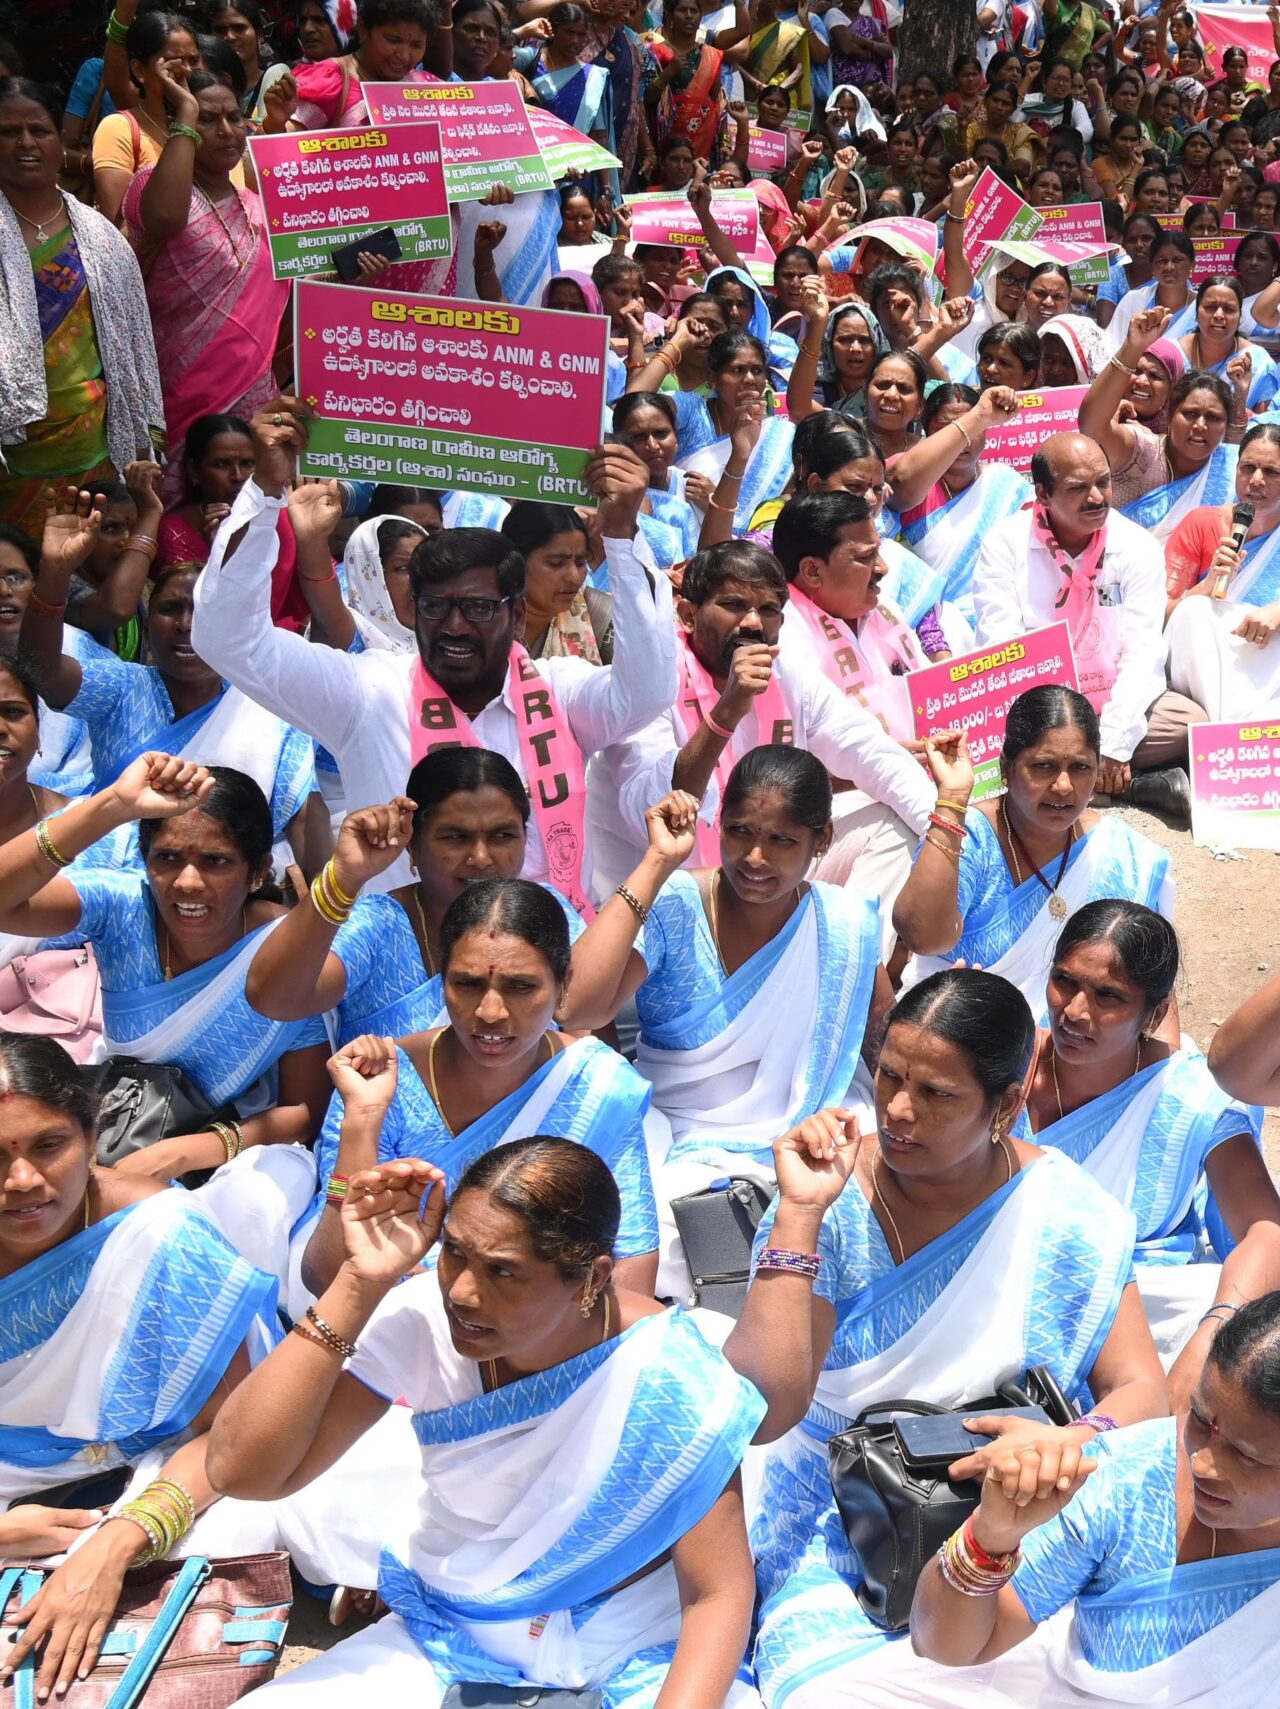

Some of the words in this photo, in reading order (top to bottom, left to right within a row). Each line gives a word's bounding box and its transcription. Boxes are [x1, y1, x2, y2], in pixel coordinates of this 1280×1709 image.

[402, 86, 474, 100] ఆశాలకు
[488, 104, 514, 116] ఇవ్వాలి.
[502, 122, 527, 135] ఇవ్వాలి.
[298, 131, 388, 154] ఆశాలకు
[273, 163, 298, 182] అర్హత
[302, 159, 331, 174] కలిగిన
[334, 155, 372, 172] ఆశాలకు
[375, 154, 398, 168] ANM
[402, 153, 410, 164] &
[414, 150, 439, 164] GNM
[277, 181, 333, 200] ఉద్యోగాలలో
[336, 176, 378, 192] అవకాశం
[382, 171, 429, 190] కల్పించాలి.
[516, 172, 548, 188] (BRTU)
[283, 210, 326, 228] పనిభారం
[328, 206, 369, 226] తగ్గించాలి
[1020, 215, 1040, 238] (BRTU)
[1059, 221, 1075, 230] ANM
[1076, 220, 1082, 229] &
[1084, 219, 1100, 228] GNM
[298, 235, 346, 249] తెలంగాణ
[278, 254, 328, 272] కార్యకర్తల
[415, 239, 449, 255] (BRTU)
[1215, 254, 1230, 262] ANM
[1084, 270, 1108, 280] (BRTU)
[371, 301, 520, 335] ఆశాలకు
[322, 326, 362, 353] అర్హత
[368, 329, 417, 352] కలిగిన
[422, 338, 488, 360] ఆశాలకు
[493, 345, 534, 366] ANM
[540, 352, 553, 368] &
[558, 353, 600, 374] GNM
[322, 351, 417, 380] ఉద్యోగాలలో
[421, 363, 494, 388] అవకాశం
[499, 371, 577, 400] కల్పించాలి.
[324, 391, 396, 416] పనిభారం
[401, 400, 472, 426] తగ్గించాలి
[344, 428, 428, 451] తెలంగాణ
[432, 438, 496, 460] గ్రామీణ
[500, 450, 559, 473] ఆరోగ్య
[306, 452, 392, 476] కార్యకర్తల
[396, 458, 452, 481] (ఆశా)
[456, 467, 516, 488] సంఘం
[538, 475, 592, 501] (BRTU
[950, 642, 1026, 682] ఆశాలకు
[926, 697, 941, 720] ప్రతి
[943, 692, 956, 708] నెల
[958, 678, 986, 702] మొదటి
[1009, 665, 1036, 684] జీతాలు
[1037, 656, 1064, 674] ఇవ్వాలి.
[1208, 750, 1234, 768] అర్హత
[1238, 745, 1270, 762] కలిగిన
